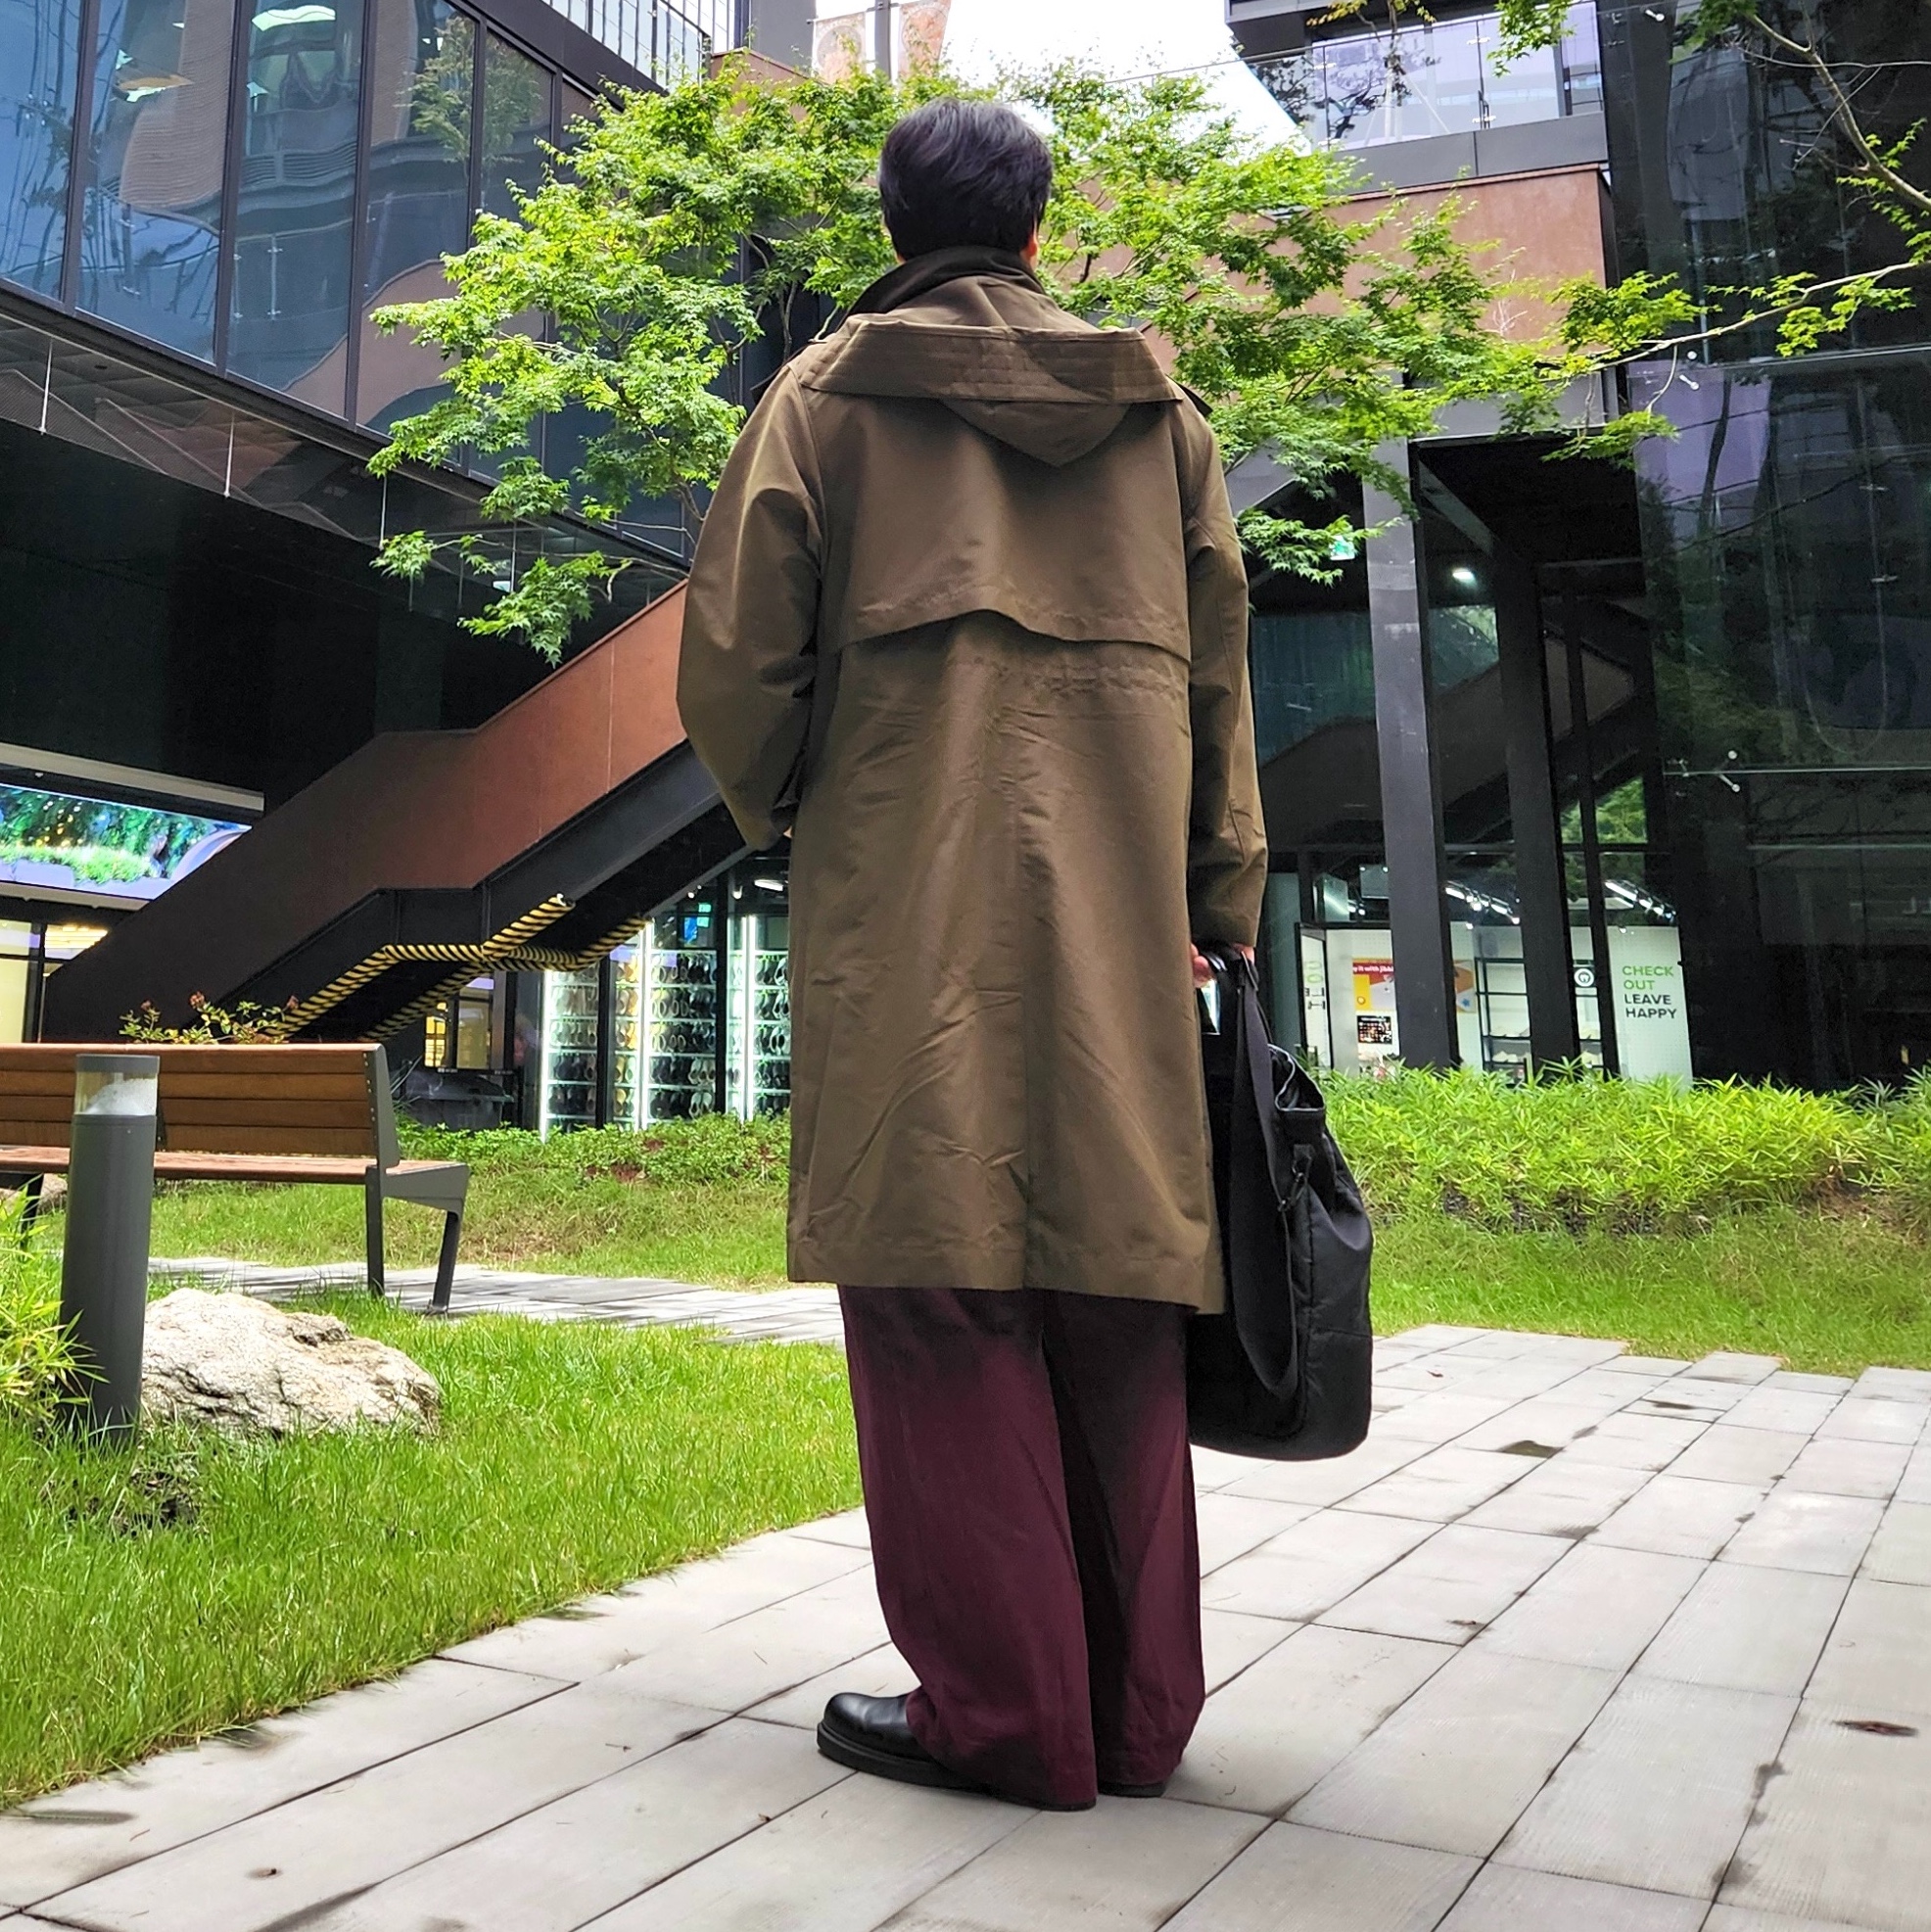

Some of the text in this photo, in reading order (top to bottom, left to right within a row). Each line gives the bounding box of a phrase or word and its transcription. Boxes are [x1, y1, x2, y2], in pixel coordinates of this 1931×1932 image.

[1622, 966, 1673, 976] CHECK
[1624, 979, 1655, 990] OUT
[1625, 993, 1672, 1005] LEAVE
[1625, 1008, 1676, 1018] HAPPY
